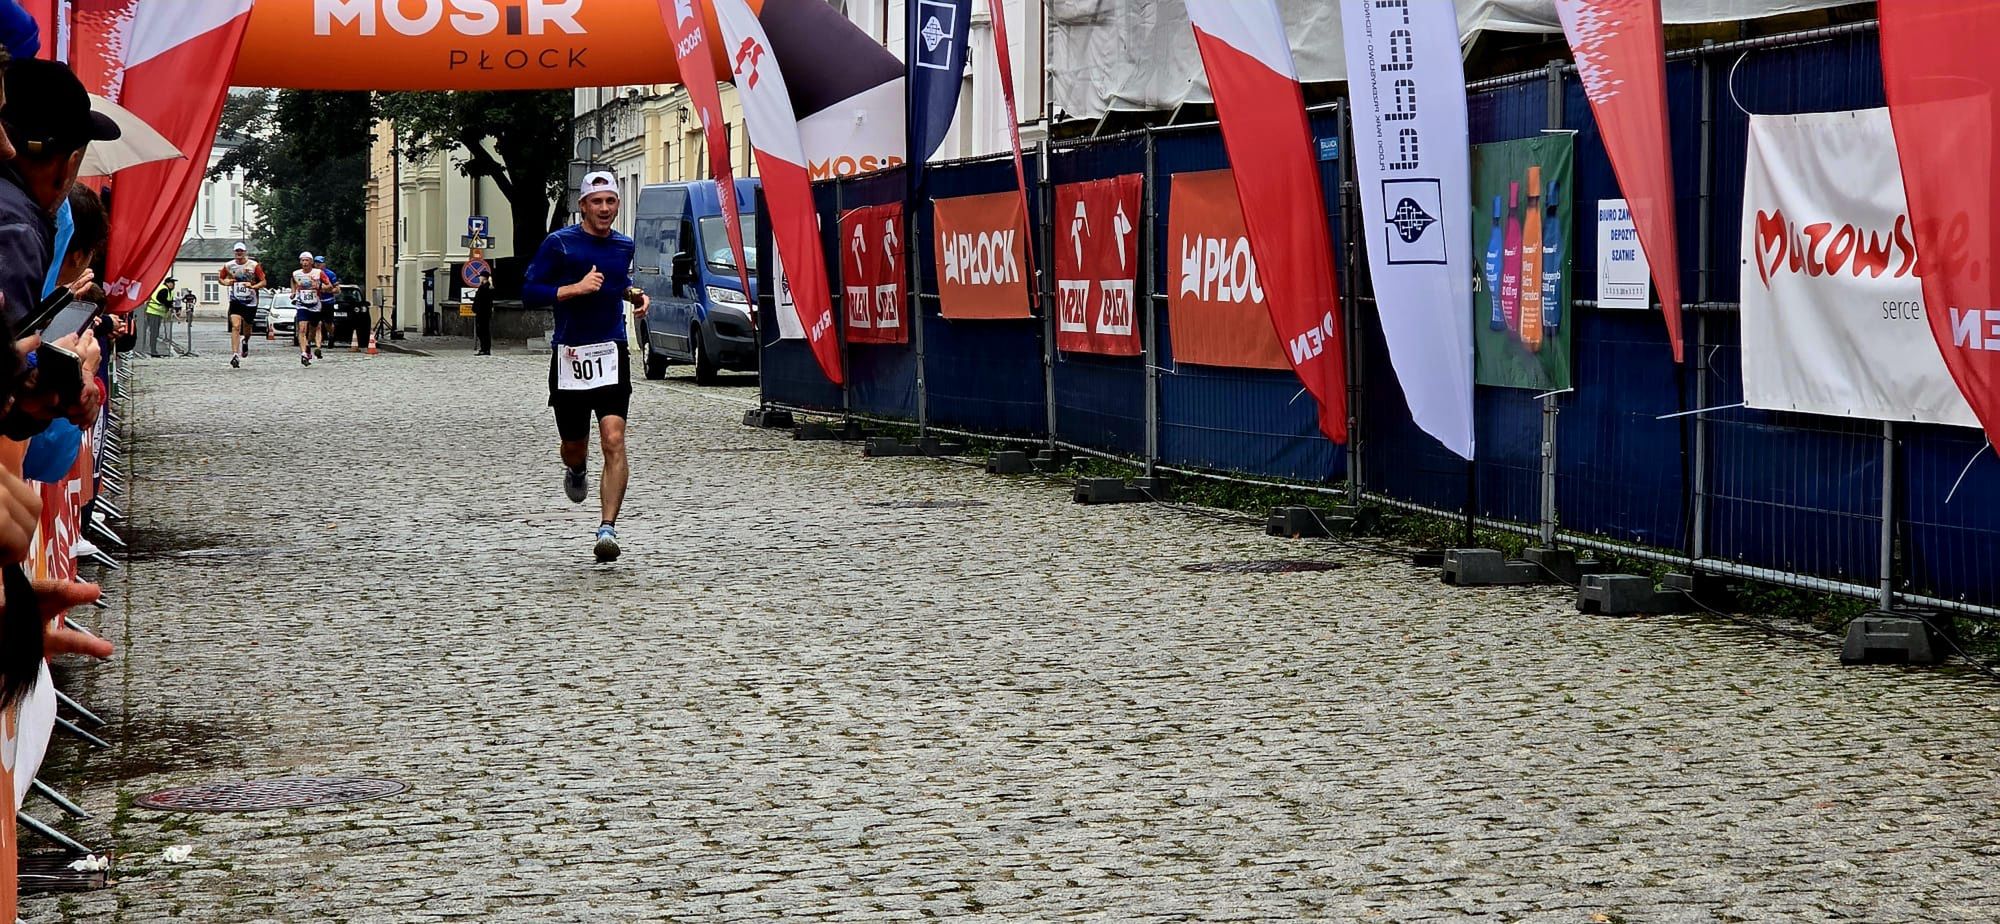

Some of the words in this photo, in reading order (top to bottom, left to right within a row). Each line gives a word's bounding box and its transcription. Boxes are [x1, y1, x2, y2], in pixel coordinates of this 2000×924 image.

[449, 47, 588, 70] PŁOCK
[1599, 208, 1617, 222] BIURO
[1610, 229, 1636, 241] DEPOZYT
[958, 229, 1020, 286] PŁOCK
[1611, 249, 1636, 262] SZATNIE
[1203, 236, 1265, 304] PŁOC
[1882, 300, 1920, 320] serce
[572, 356, 603, 380] 901
